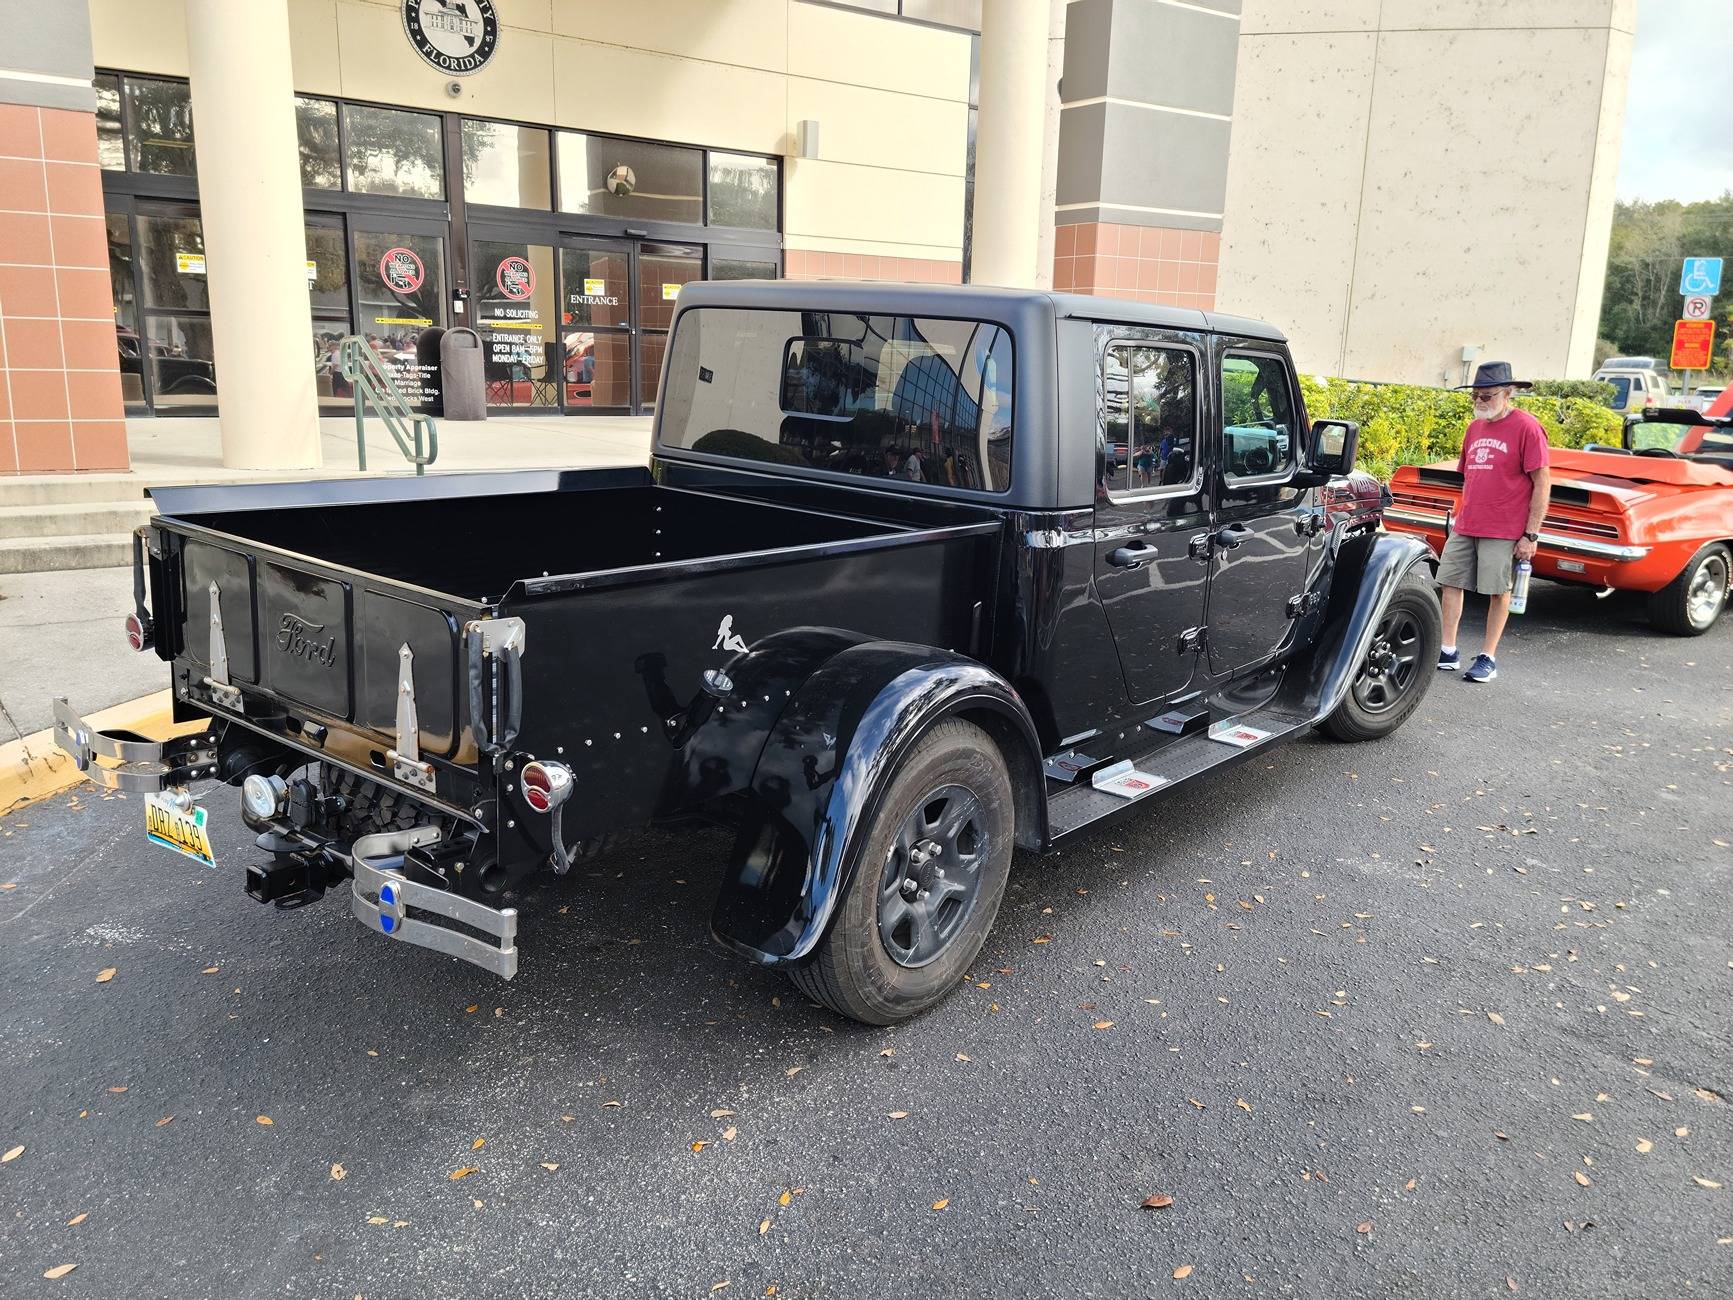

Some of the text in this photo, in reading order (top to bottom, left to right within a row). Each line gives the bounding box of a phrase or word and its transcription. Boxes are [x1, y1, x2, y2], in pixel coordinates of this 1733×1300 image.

[410, 22, 419, 30] 18
[422, 43, 484, 70] FLORIDA
[394, 254, 410, 263] NO
[509, 263, 523, 271] NO
[570, 295, 619, 306] ENTRANCE
[494, 308, 539, 319] NO SOLICITING
[492, 333, 542, 344] ENTRANCE ONLY
[493, 344, 510, 353] OPEN
[276, 612, 337, 668] Ford
